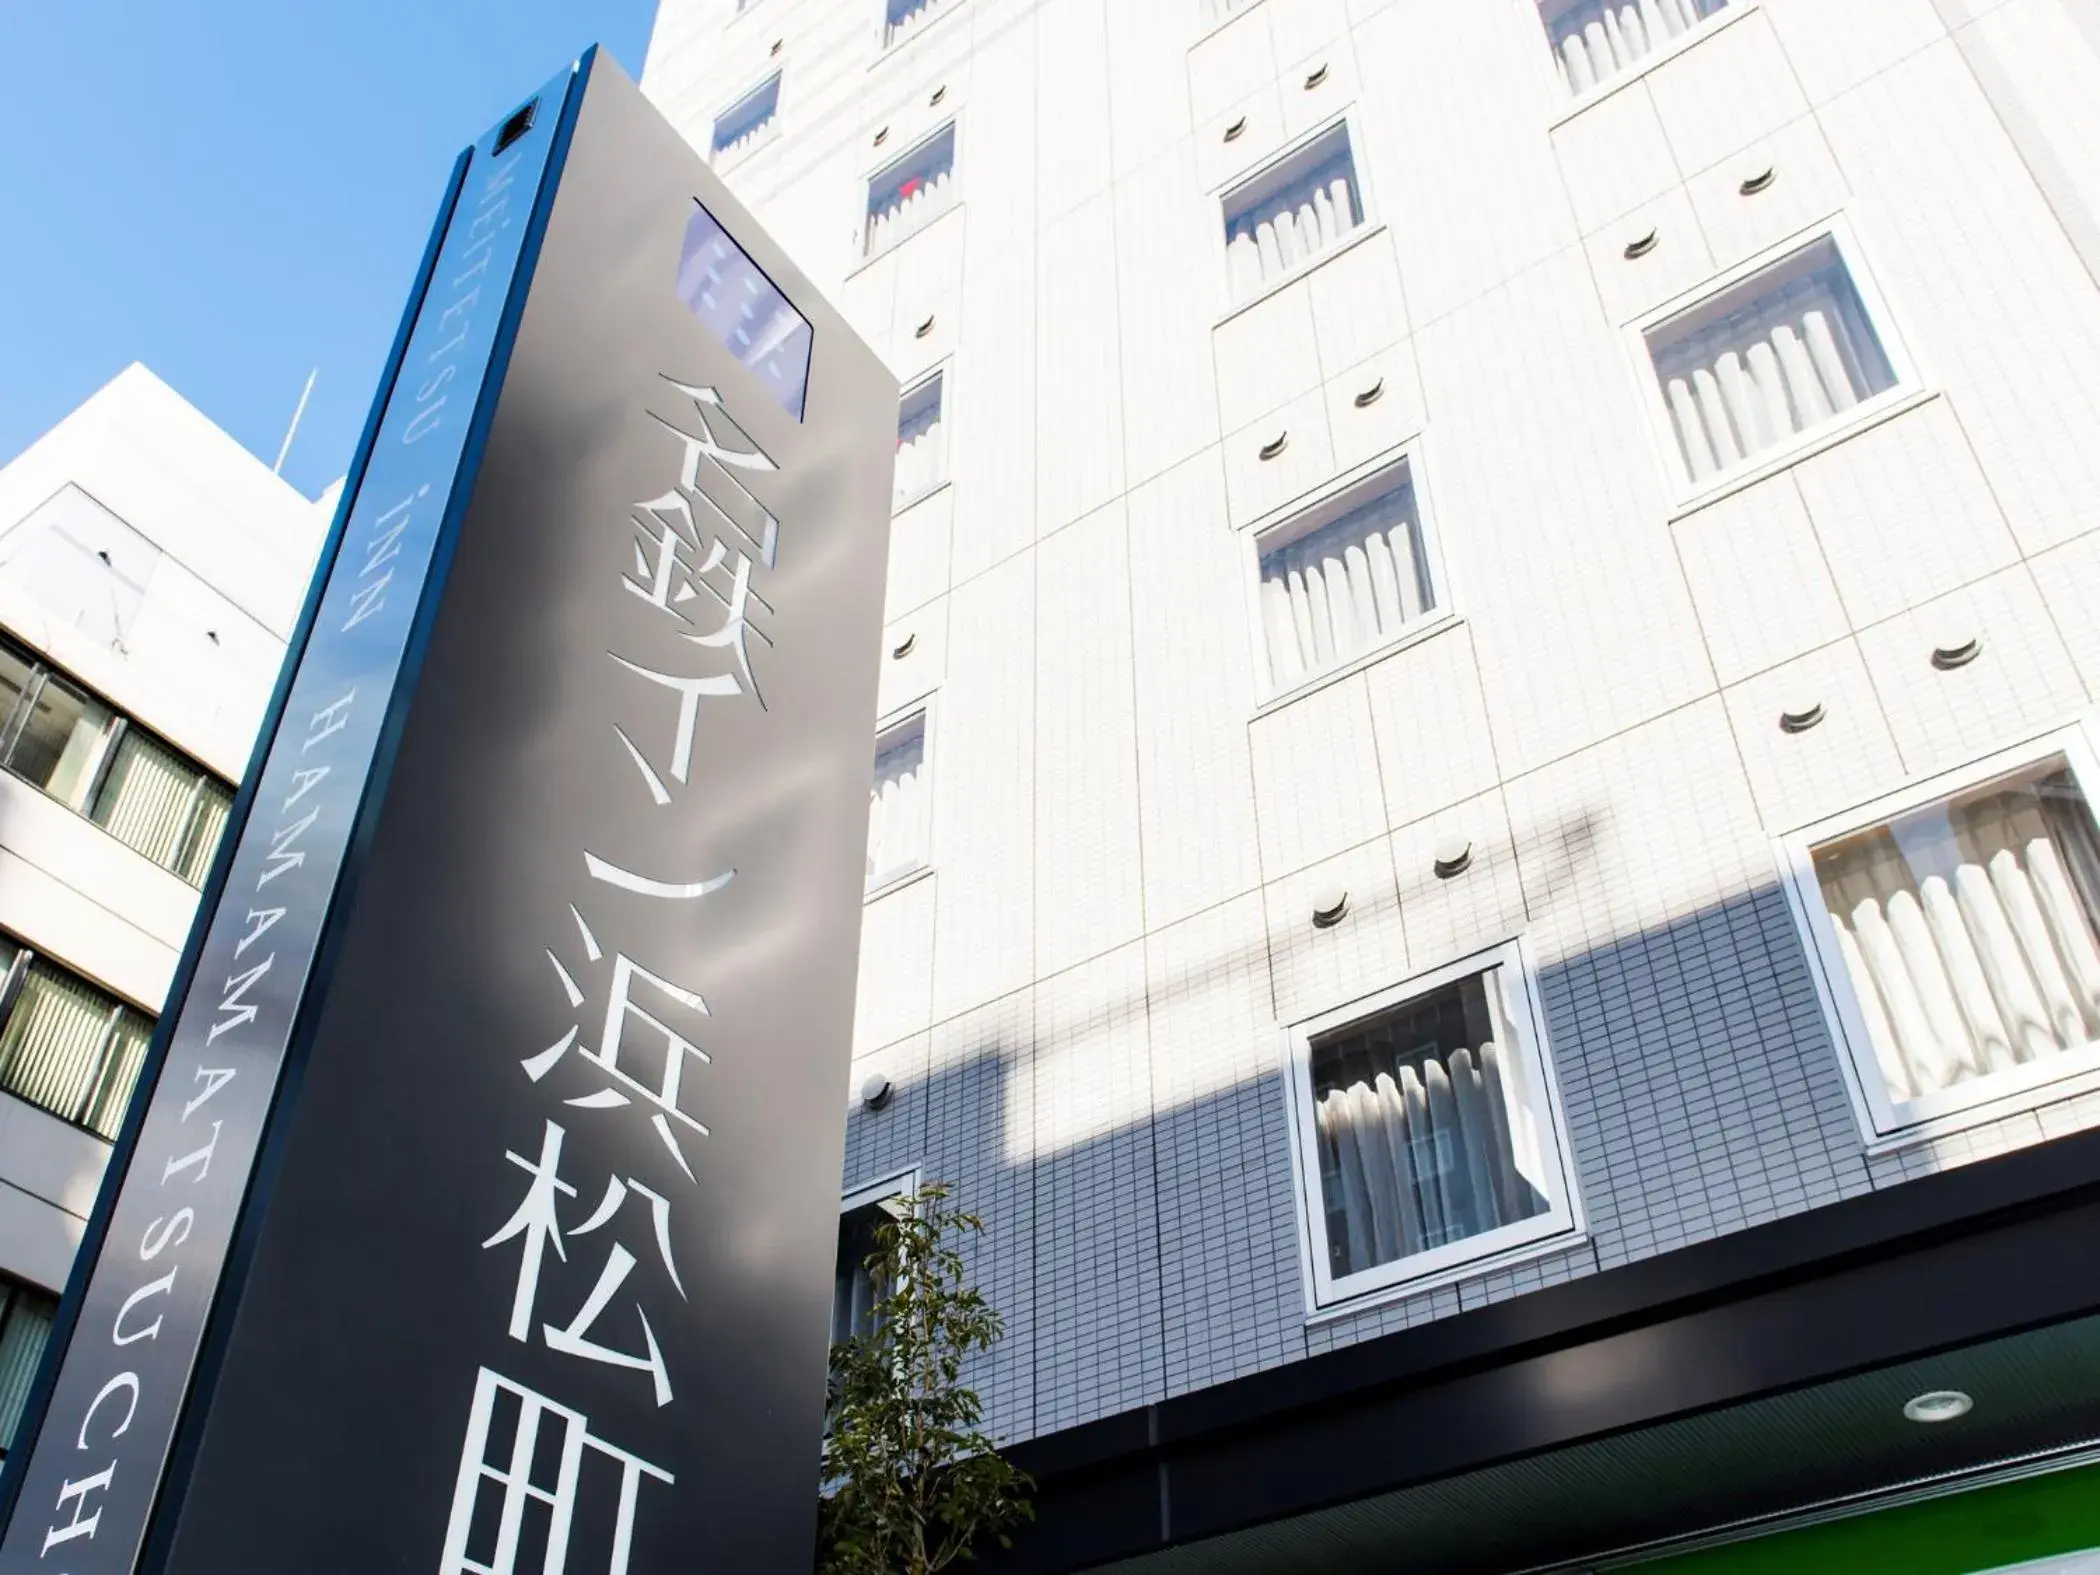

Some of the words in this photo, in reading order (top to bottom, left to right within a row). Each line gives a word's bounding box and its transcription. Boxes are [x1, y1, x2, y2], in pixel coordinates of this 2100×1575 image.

[40, 685, 358, 1575] HAMAMATSUCH
[439, 372, 780, 1575] 名鉄イン浜松町
